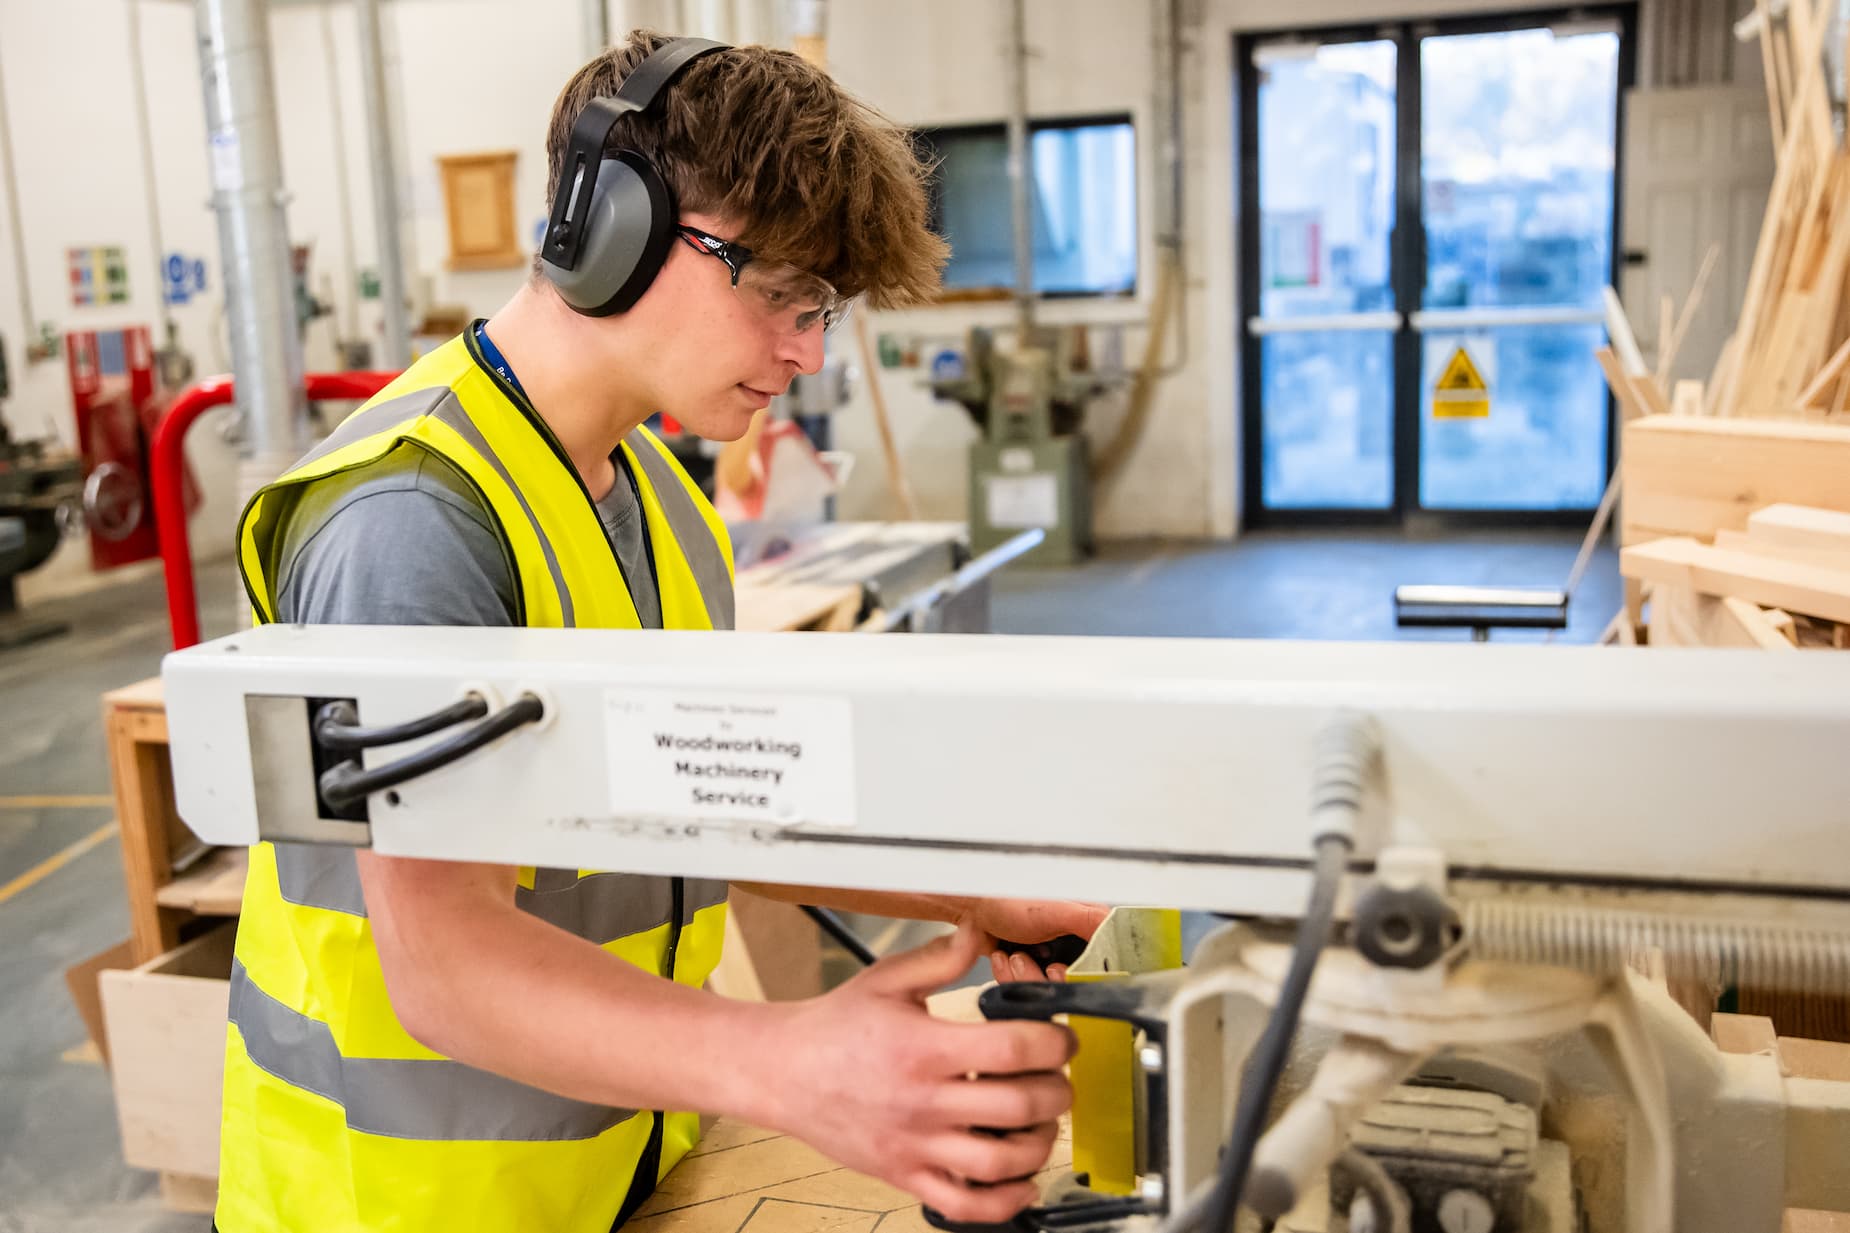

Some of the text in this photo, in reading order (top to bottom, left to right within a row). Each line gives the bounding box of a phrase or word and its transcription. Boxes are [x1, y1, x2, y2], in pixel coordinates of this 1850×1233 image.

[654, 733, 801, 759] Woodworking
[675, 761, 783, 784] Machinery
[692, 787, 769, 807] Service
